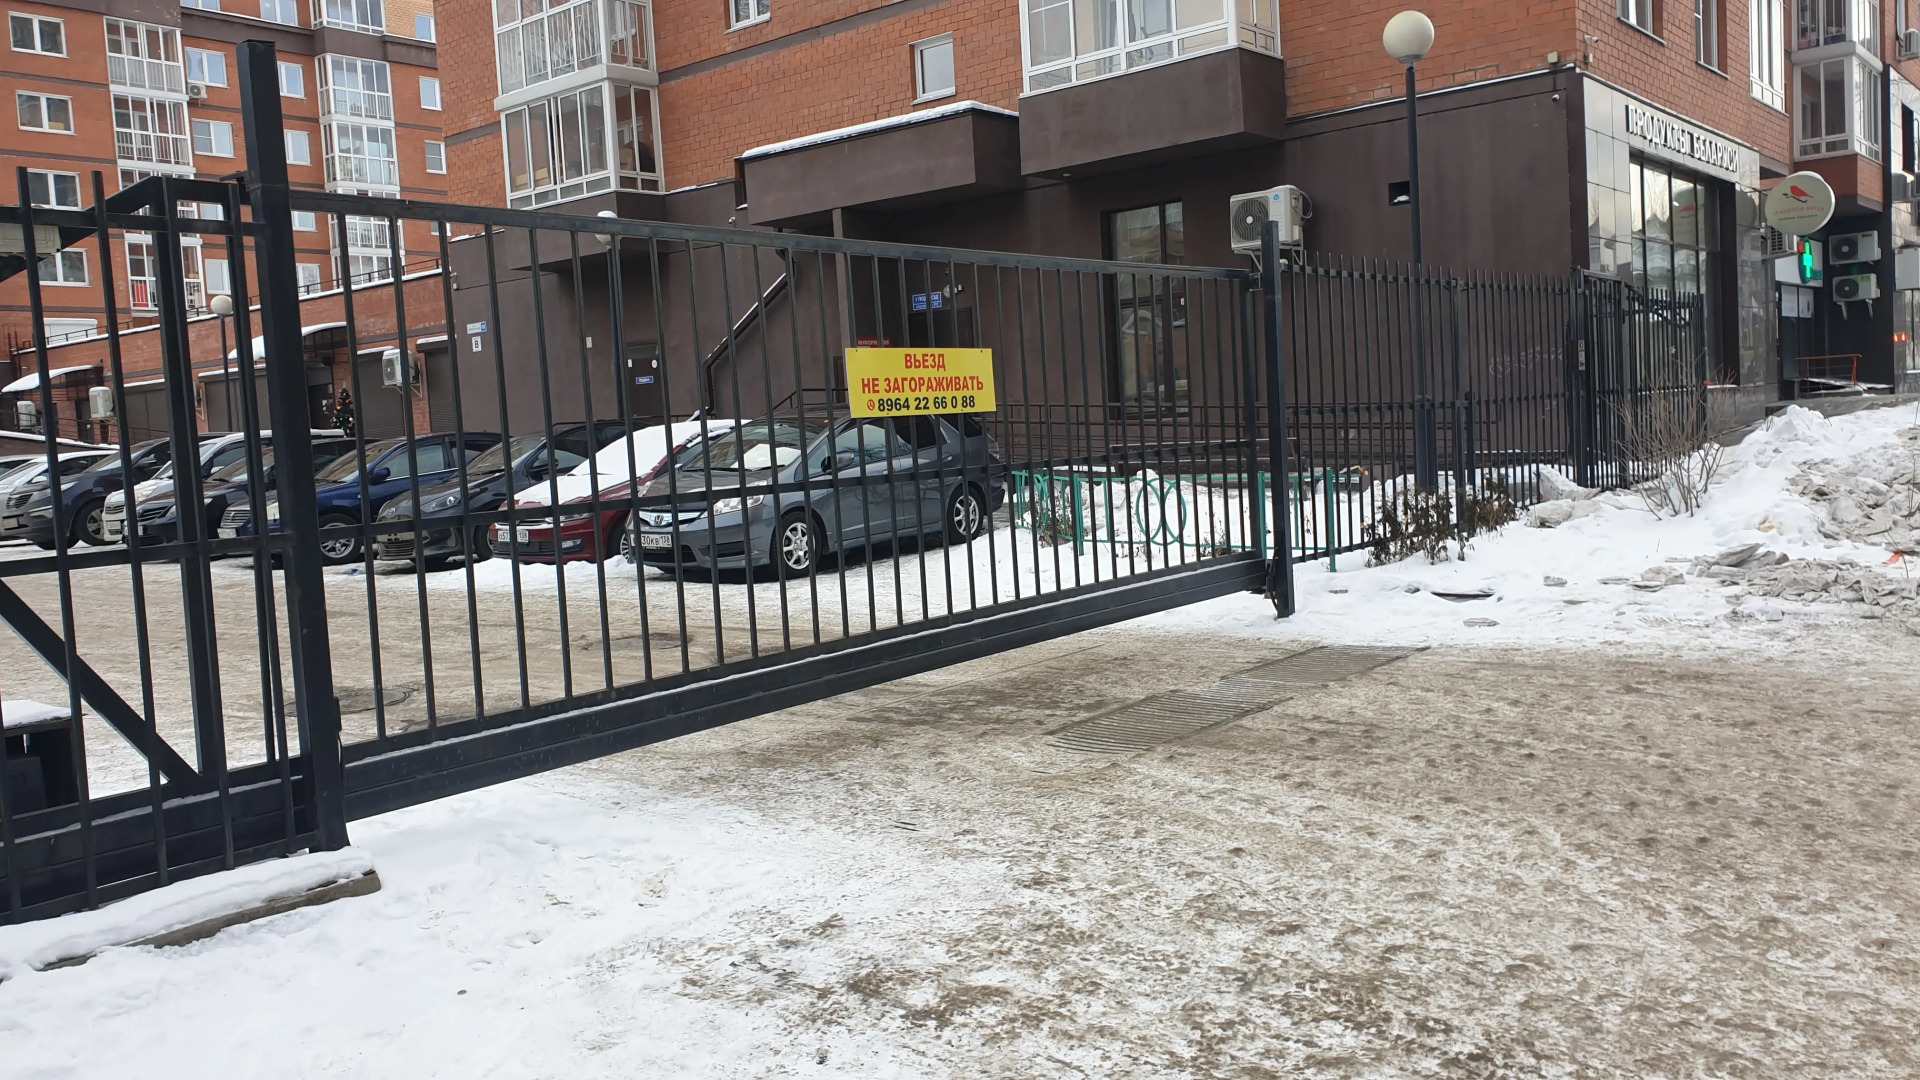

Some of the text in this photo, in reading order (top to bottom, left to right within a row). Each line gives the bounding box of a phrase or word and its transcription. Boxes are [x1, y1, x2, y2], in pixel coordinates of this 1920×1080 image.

[1626, 104, 1739, 173] ПРОДУКТЫ БЕЛАРУСИ
[904, 353, 946, 372] ВЬЕЗД
[861, 376, 984, 394] НЕ ЗАГОРАЖИВАТЬ
[877, 395, 976, 412] 8964 22 66 0 88
